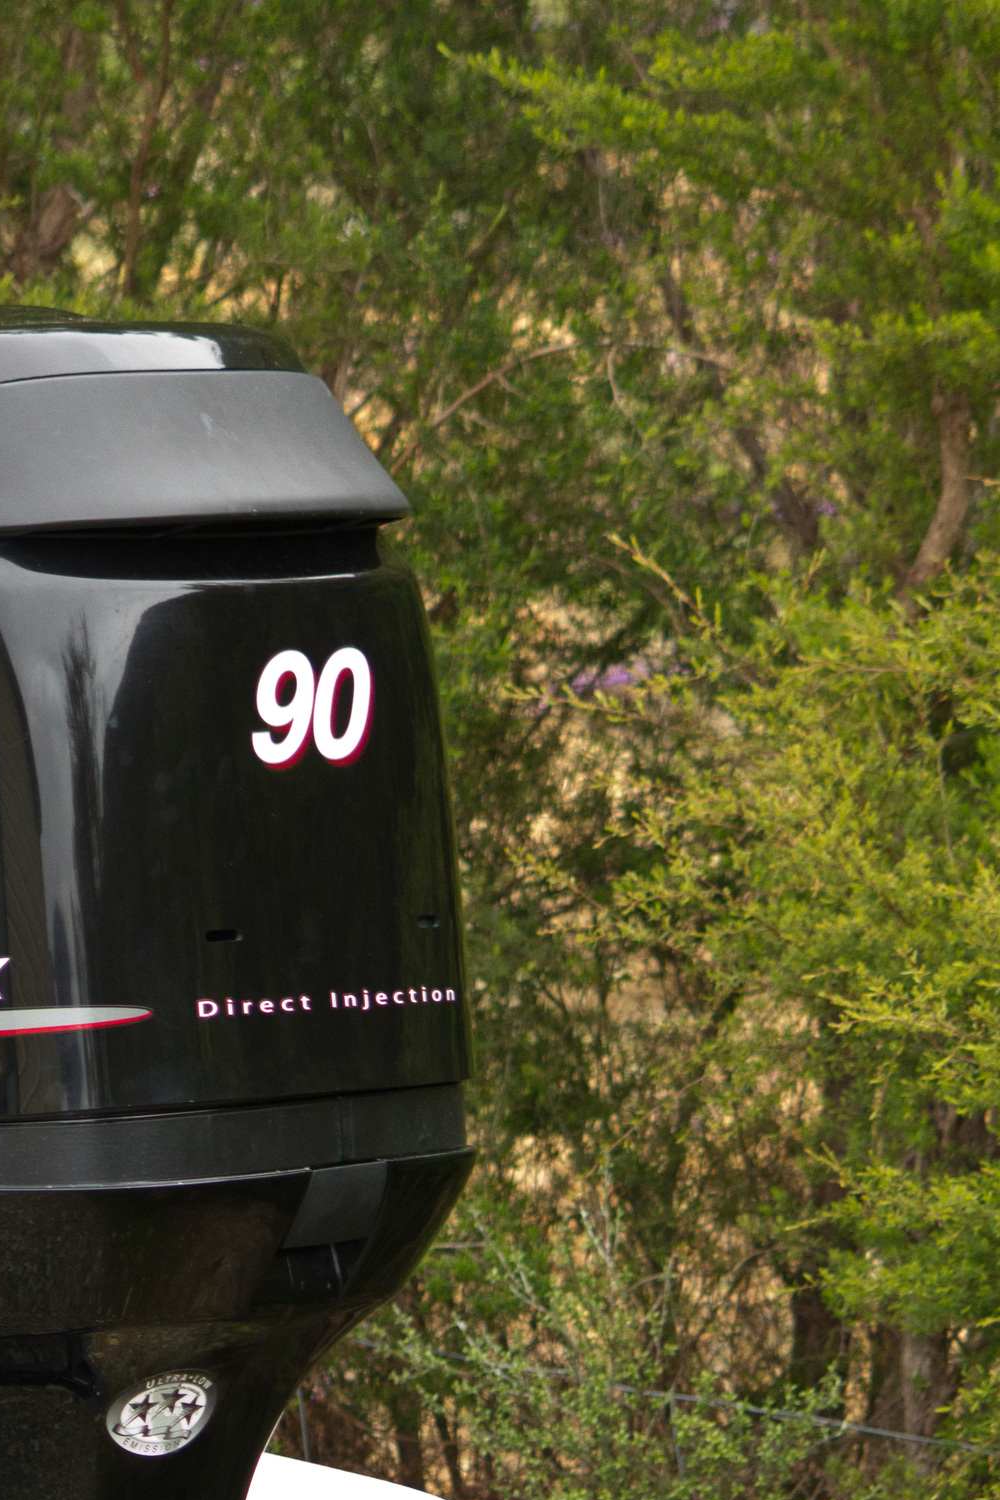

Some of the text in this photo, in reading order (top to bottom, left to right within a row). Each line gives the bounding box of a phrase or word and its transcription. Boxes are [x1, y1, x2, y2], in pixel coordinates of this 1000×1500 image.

[252, 647, 375, 771] 90
[197, 986, 456, 1018] Direct Injection
[122, 1437, 180, 1454] EMISSION
